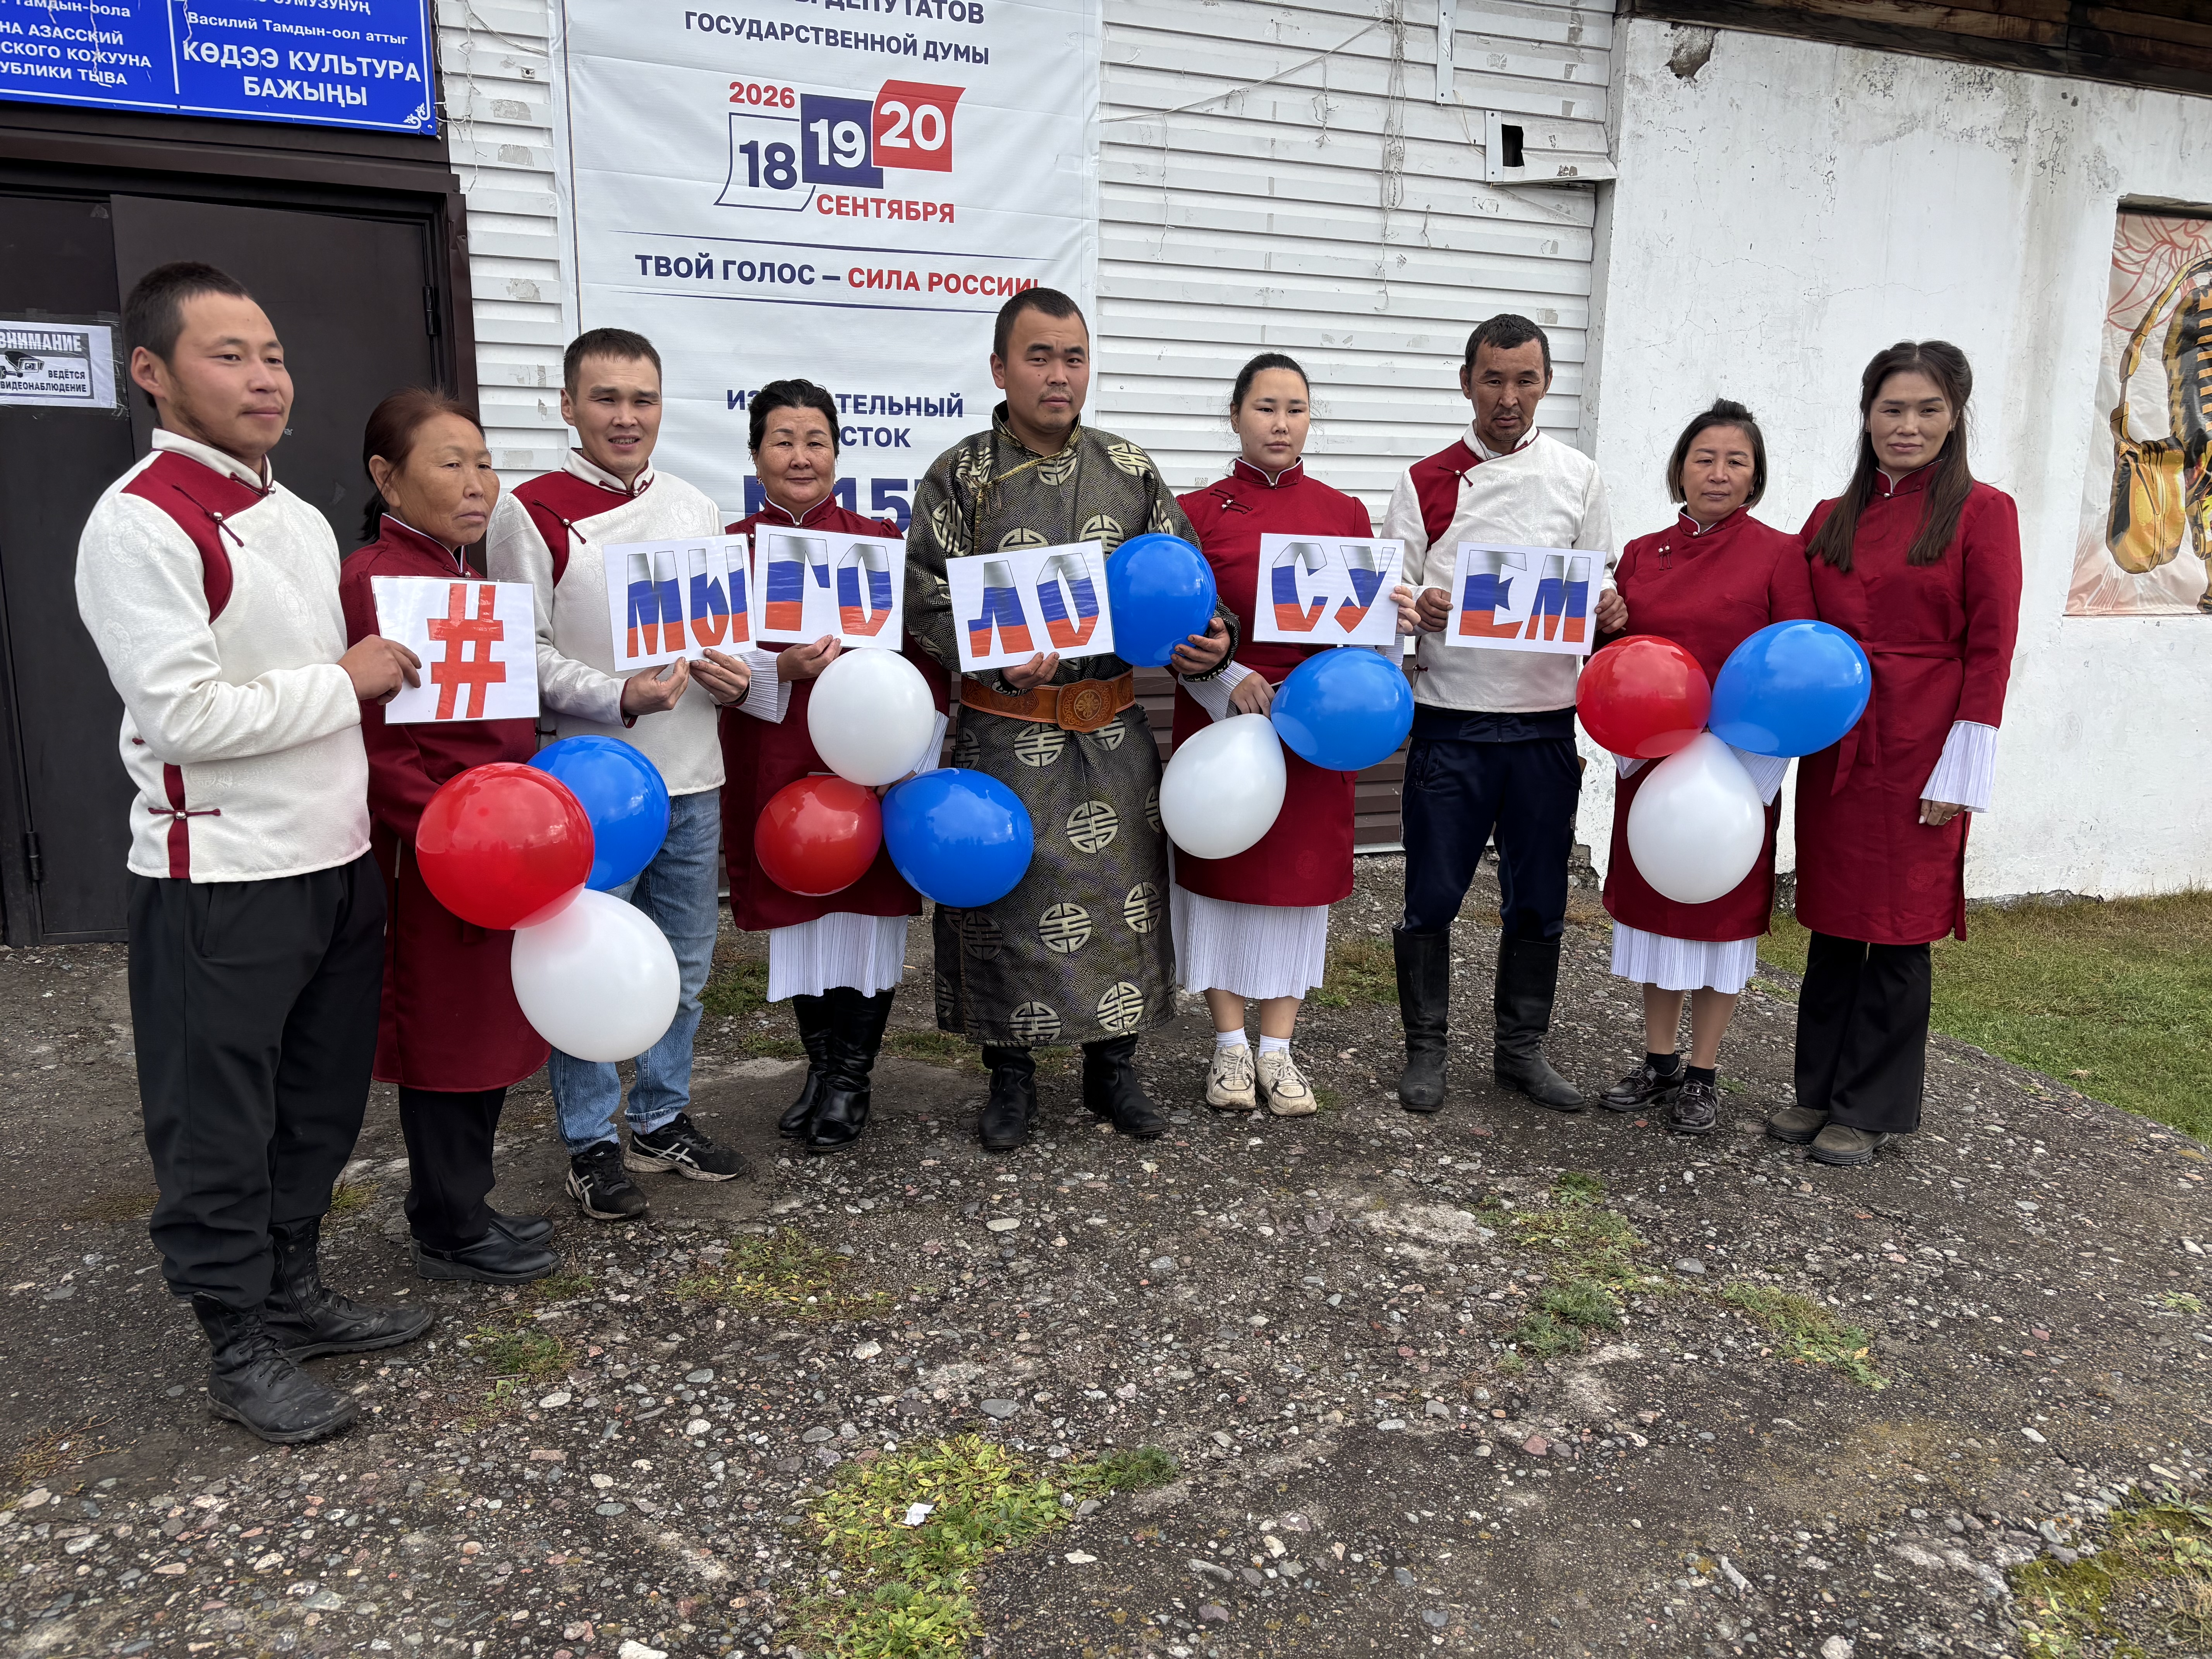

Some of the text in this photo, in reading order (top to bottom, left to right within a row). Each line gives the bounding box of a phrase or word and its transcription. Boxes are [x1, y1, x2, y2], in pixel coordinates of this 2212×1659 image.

[28, 24, 123, 45] АЗАССКИЙ
[188, 12, 408, 44] Василий Тамдын-оол аттыг
[685, 11, 988, 64] ГОСУДАРСТВЕННОЙ ДУМЫ
[67, 48, 151, 67] КОЖУУНА
[184, 41, 421, 82] КӨДЭЭ КУЛЬТУРА
[77, 69, 127, 84] ТЫВА
[244, 76, 368, 107] БАЖЫҢЫ
[730, 82, 795, 108] 2026
[739, 101, 946, 190] 18 19 20
[817, 194, 954, 223] СЕНТЯБРЯ
[635, 252, 713, 279] ТВОЙ
[723, 260, 815, 285] ГОЛОС
[848, 267, 920, 291] СИЛА
[0, 331, 81, 352] ВНИМАНИЕ
[0, 381, 86, 392] ВИДЕОНАБЛЮДЕНИЕ
[48, 369, 85, 380] ВЕДЁТСЯ
[727, 390, 963, 417] ИТЕЛЬНЫЙ
[840, 426, 911, 448] СТОК
[765, 534, 893, 636] ГО
[1272, 542, 1396, 633] СУ
[1458, 550, 1591, 642] ЕМ
[627, 545, 749, 658] МЫ
[968, 553, 1099, 658] ЛО
